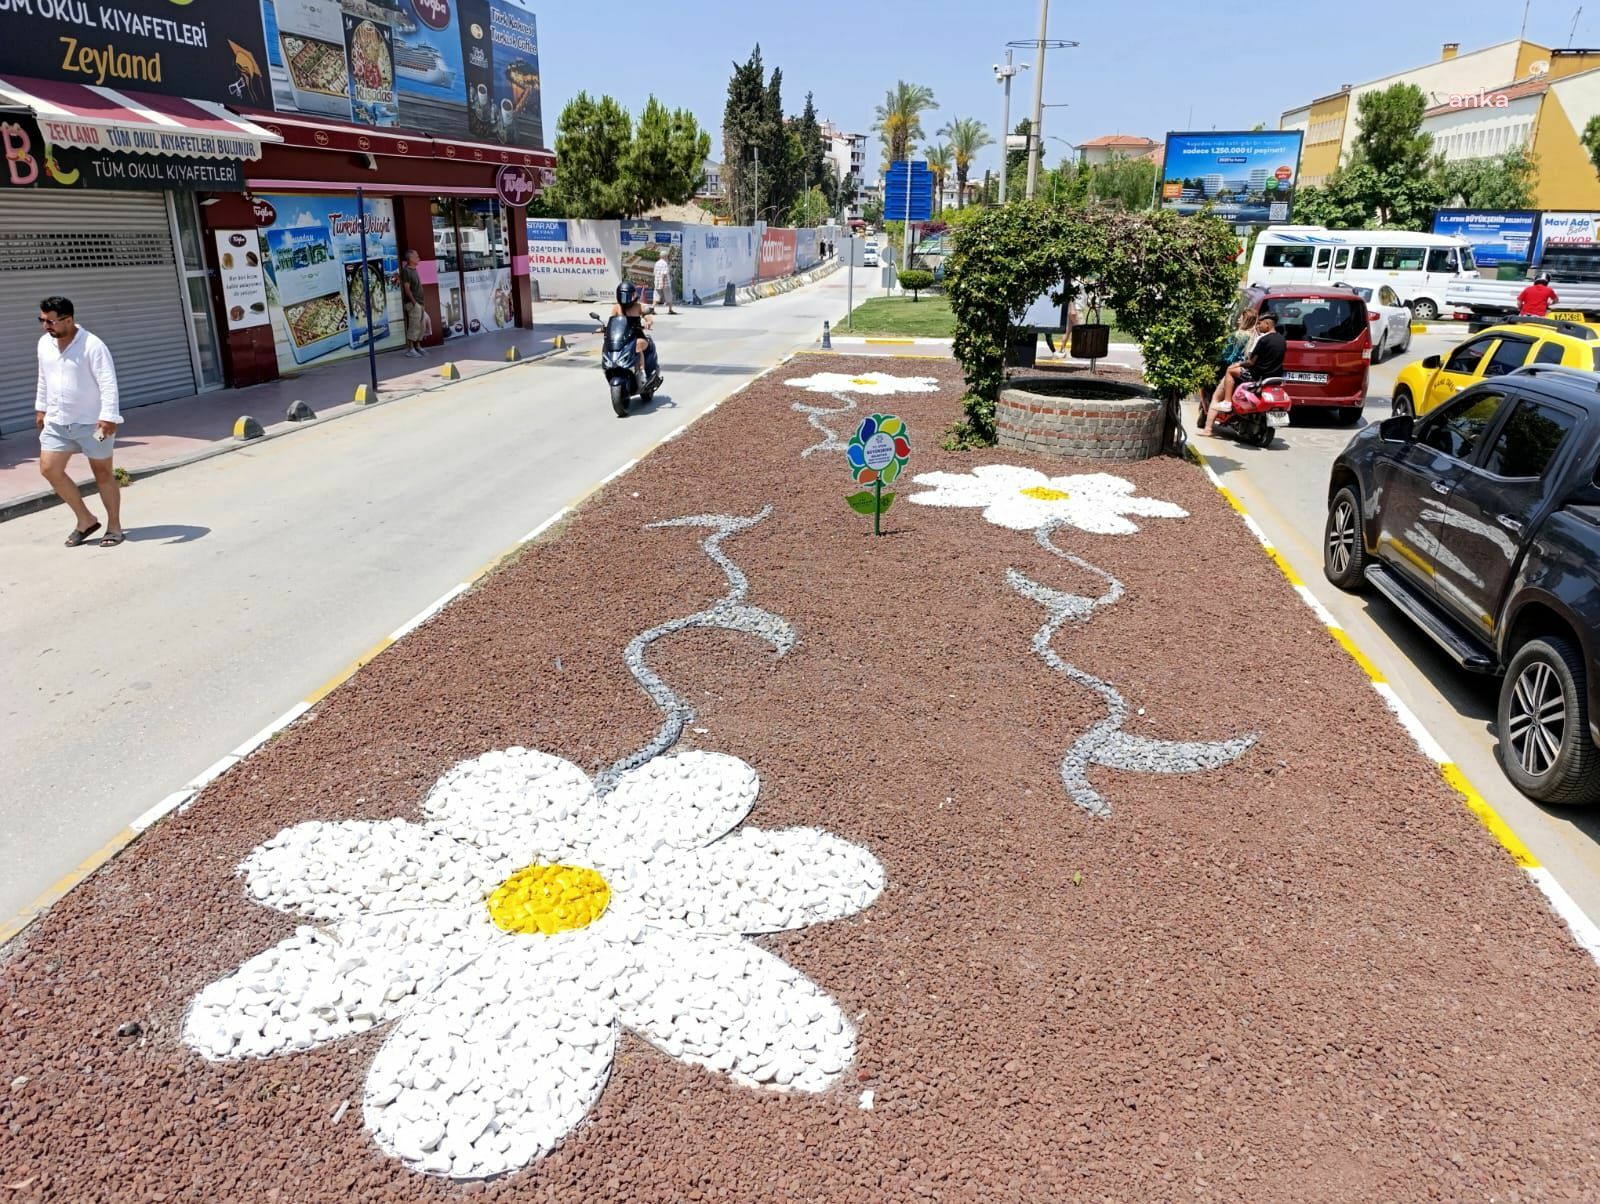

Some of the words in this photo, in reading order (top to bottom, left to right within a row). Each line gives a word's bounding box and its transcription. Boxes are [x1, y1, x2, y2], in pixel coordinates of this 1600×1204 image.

[37, 0, 97, 27] OKUL
[99, 6, 208, 48] KIYAFETLERİ
[59, 36, 162, 85] Zeyland
[46, 122, 100, 145] ZEYLAND
[106, 125, 131, 147] TÜM
[133, 131, 159, 149] OKUL
[159, 133, 216, 154] KIYAFETLERİ
[217, 139, 256, 157] BULUNUR
[1183, 147, 1209, 155] sadece
[91, 157, 126, 178] TÜM
[128, 163, 164, 179] OKUL
[166, 163, 237, 181] KIYAFETLERİ
[1544, 218, 1569, 226] Mavi
[1570, 218, 1590, 226] Ada
[528, 254, 606, 265] KİRALAMALARI
